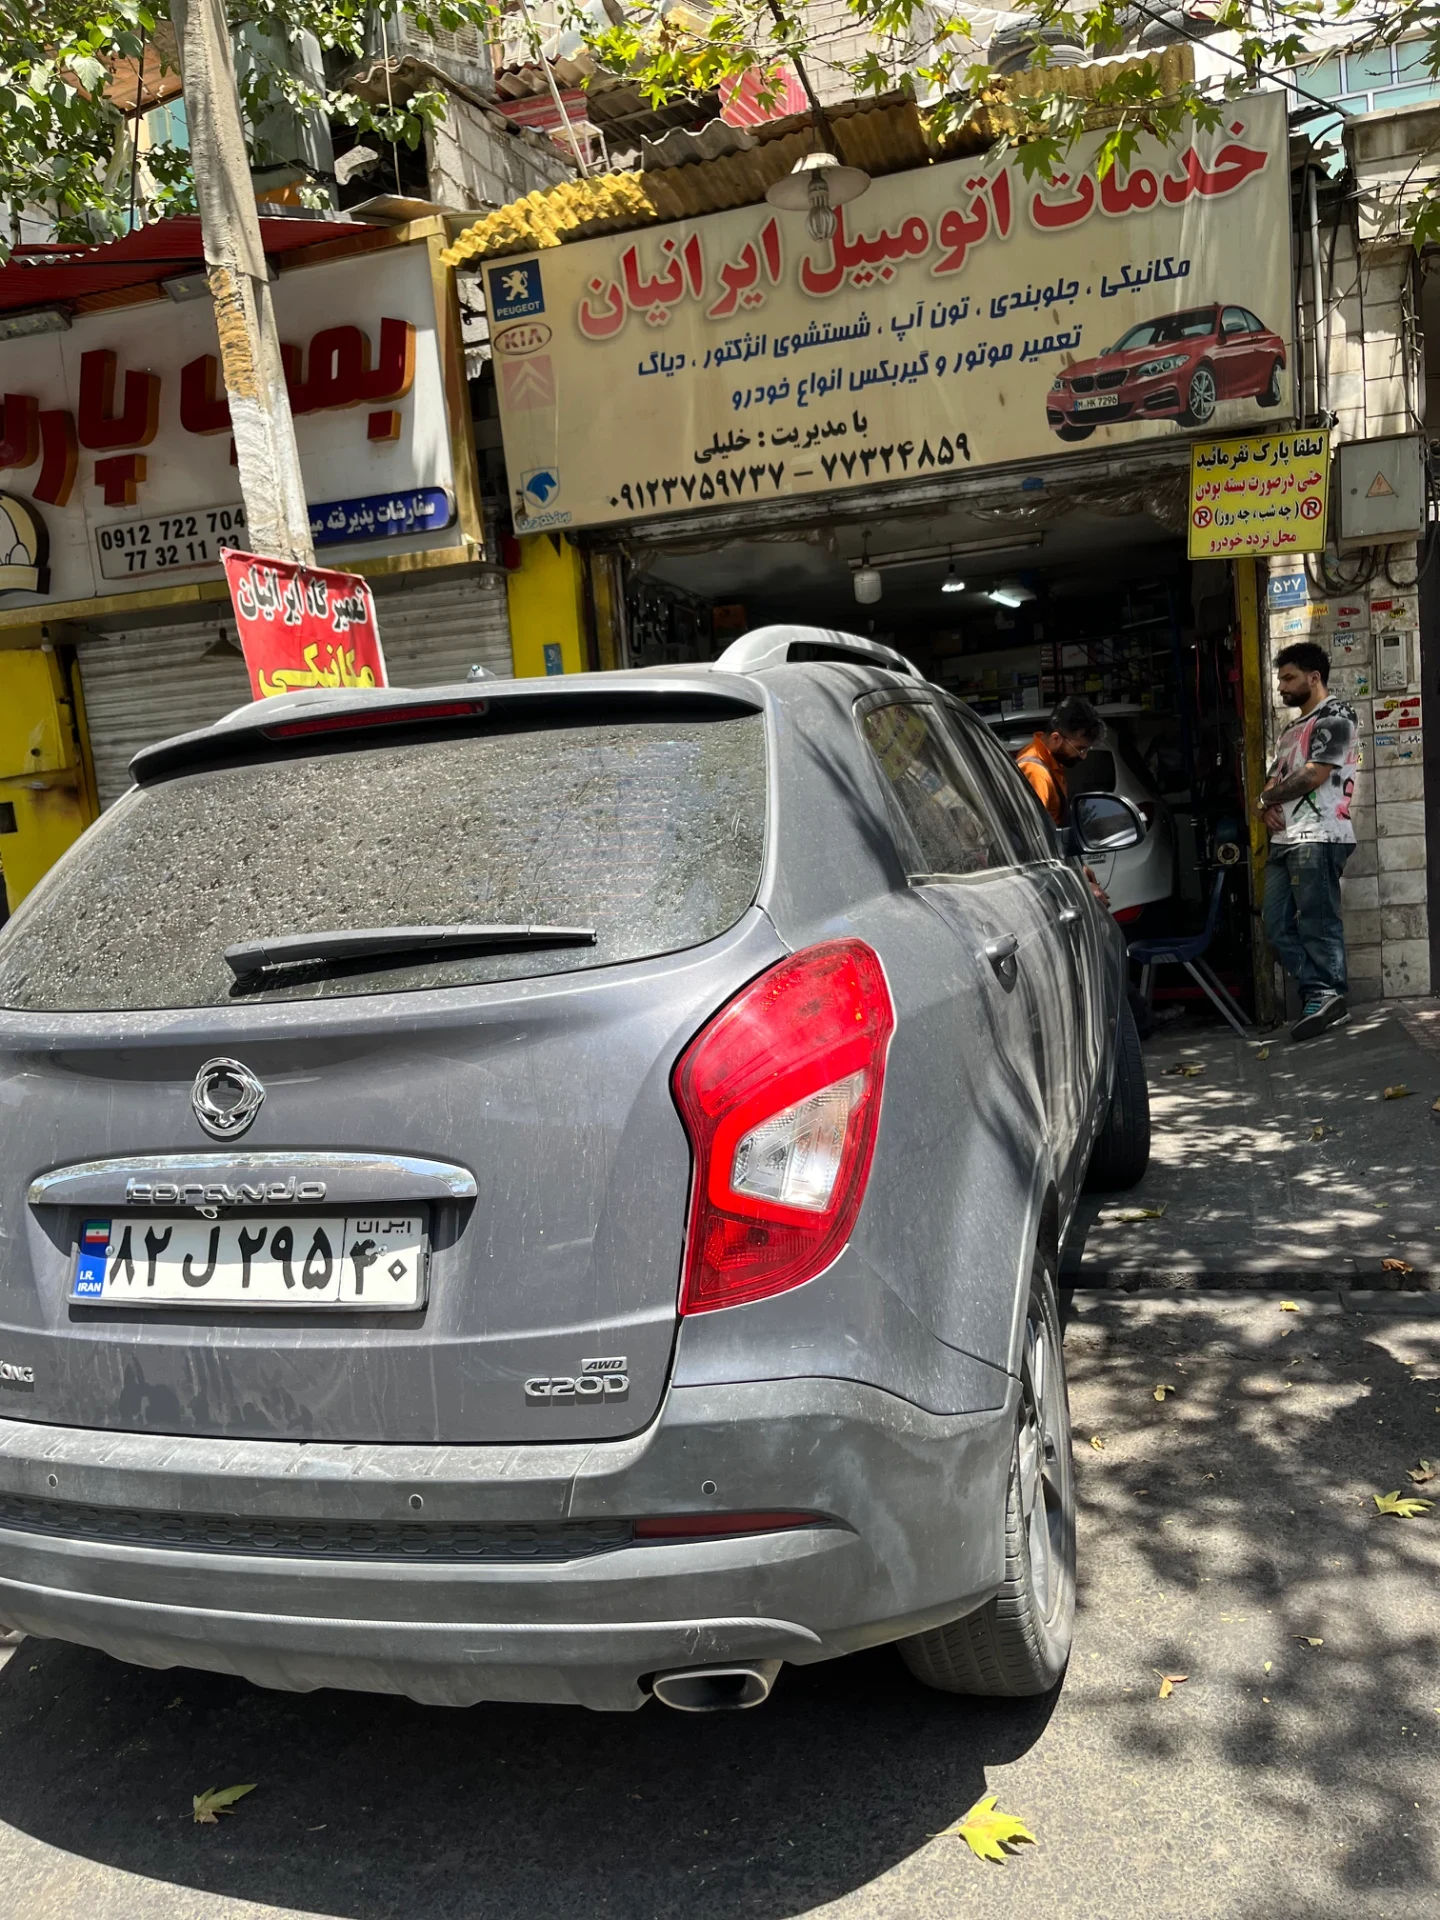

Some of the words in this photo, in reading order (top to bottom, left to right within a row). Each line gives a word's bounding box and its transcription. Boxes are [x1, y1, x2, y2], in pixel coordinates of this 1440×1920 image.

[1032, 120, 1268, 228] خدمات
[801, 168, 1011, 294] اتومبیل
[580, 216, 781, 336] ایرانیان
[1100, 256, 1191, 298] مکانیکی
[496, 300, 541, 318] PEUGEOT
[930, 296, 969, 329] تون
[989, 278, 1079, 319] جلوبندی
[773, 311, 871, 358] شستشوی
[891, 302, 924, 341] آپ
[503, 331, 543, 350] KIA
[703, 333, 767, 369] انژکتور
[1018, 323, 1083, 363] تعمیر
[637, 351, 685, 378] دیاگ
[848, 349, 929, 392] گیربکس
[935, 355, 947, 378] و
[952, 341, 1013, 374] موتور
[731, 376, 790, 411] خودرو
[797, 367, 843, 408] انواع
[770, 418, 847, 450] مدیریت
[851, 409, 868, 438] با
[693, 428, 751, 464] خلیلی
[1196, 443, 1249, 471] نفرمائید
[1252, 441, 1289, 467] پارک
[1293, 435, 1324, 458] لطفا
[608, 460, 785, 511] ۰۹۱۲۳۷۵۹۷۳۷
[820, 432, 971, 482] ۷۷۳۲۴۸۵۹
[1223, 476, 1246, 497] بسته
[1297, 470, 1323, 493] حتی
[1195, 481, 1221, 502] بودن
[326, 503, 375, 534] پذیرفته
[376, 494, 435, 525] سفارشات
[1237, 507, 1250, 525] چه
[101, 524, 151, 551] 0912
[160, 517, 198, 541] 722
[207, 508, 246, 533] 704
[1210, 532, 1243, 553] خودرو
[1246, 531, 1270, 549] تردد
[1272, 530, 1297, 548] محل
[124, 551, 148, 572] 77
[156, 545, 180, 566] 32
[189, 540, 208, 561] 11
[237, 563, 305, 626] ایرانیان
[1273, 577, 1301, 593] ۵۲۷
[258, 642, 376, 698] مکانیکی
[356, 1220, 411, 1234] ایران
[349, 1239, 408, 1295] ۴۰
[77, 1282, 102, 1292] IRAN
[585, 1359, 624, 1371] AWD
